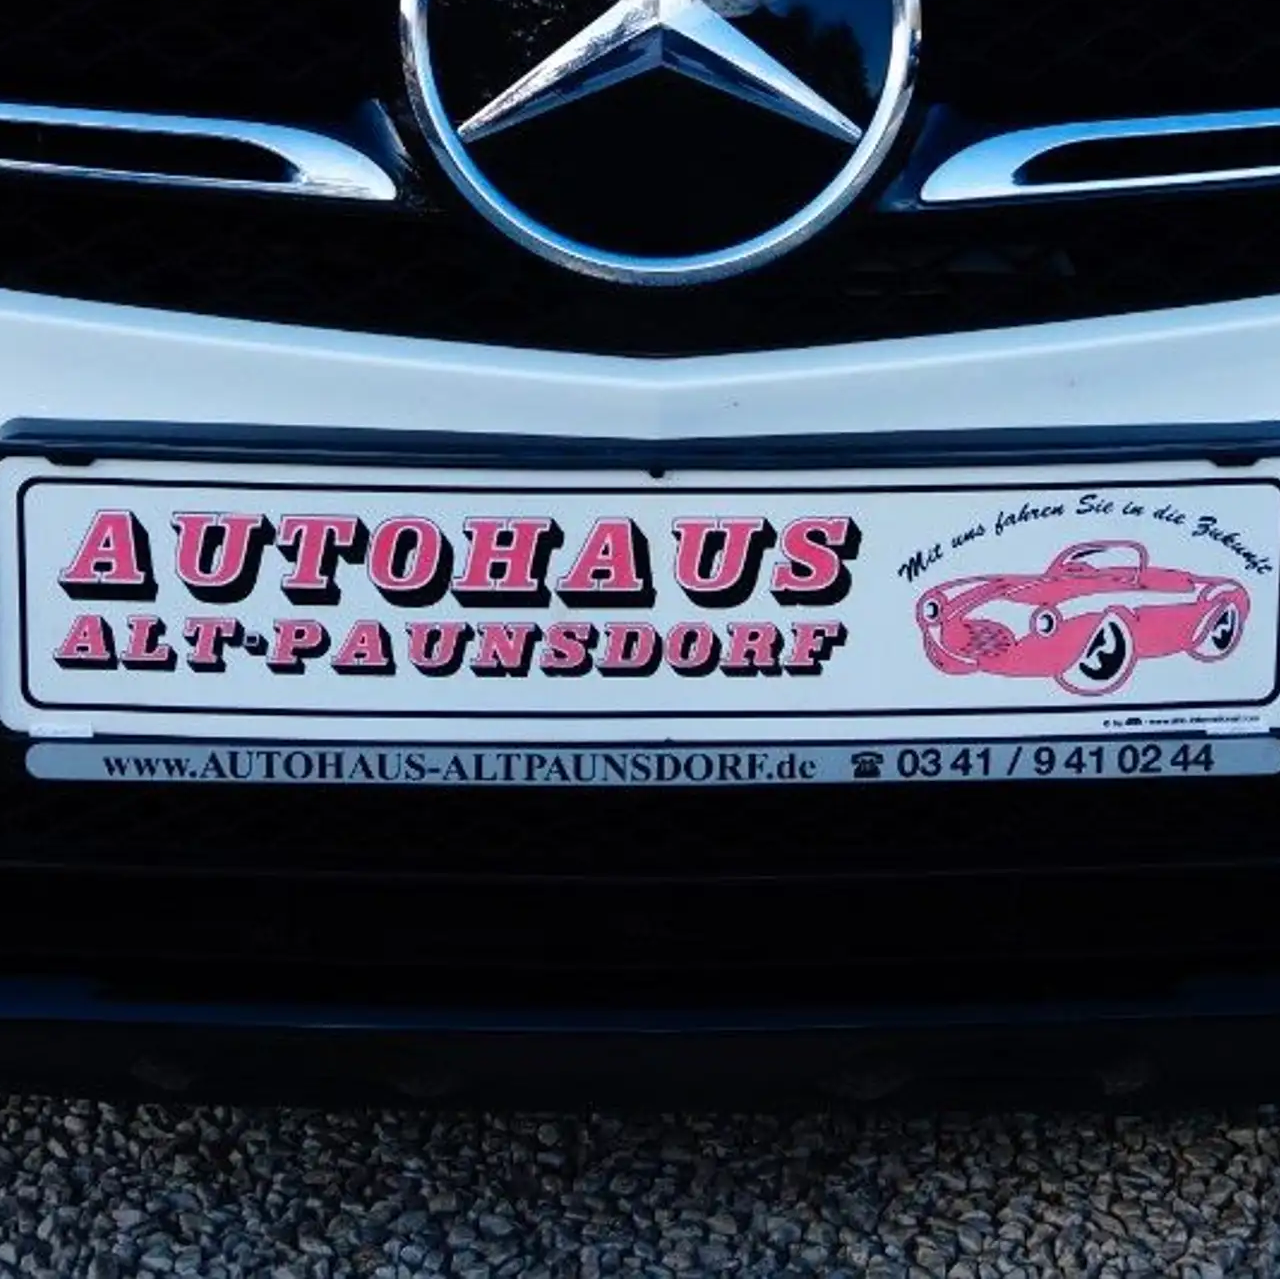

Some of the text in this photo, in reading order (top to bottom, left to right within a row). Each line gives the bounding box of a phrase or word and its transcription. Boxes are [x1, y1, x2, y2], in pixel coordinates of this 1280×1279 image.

[58, 508, 862, 609] AUTOHAUS
[897, 493, 1273, 583] Mit uns fahren Sie in die Zukunft
[53, 614, 848, 678] ALT-PAUNSDORF
[103, 750, 817, 782] www.AUTOHAUS-ALTPAUNSDORF.de
